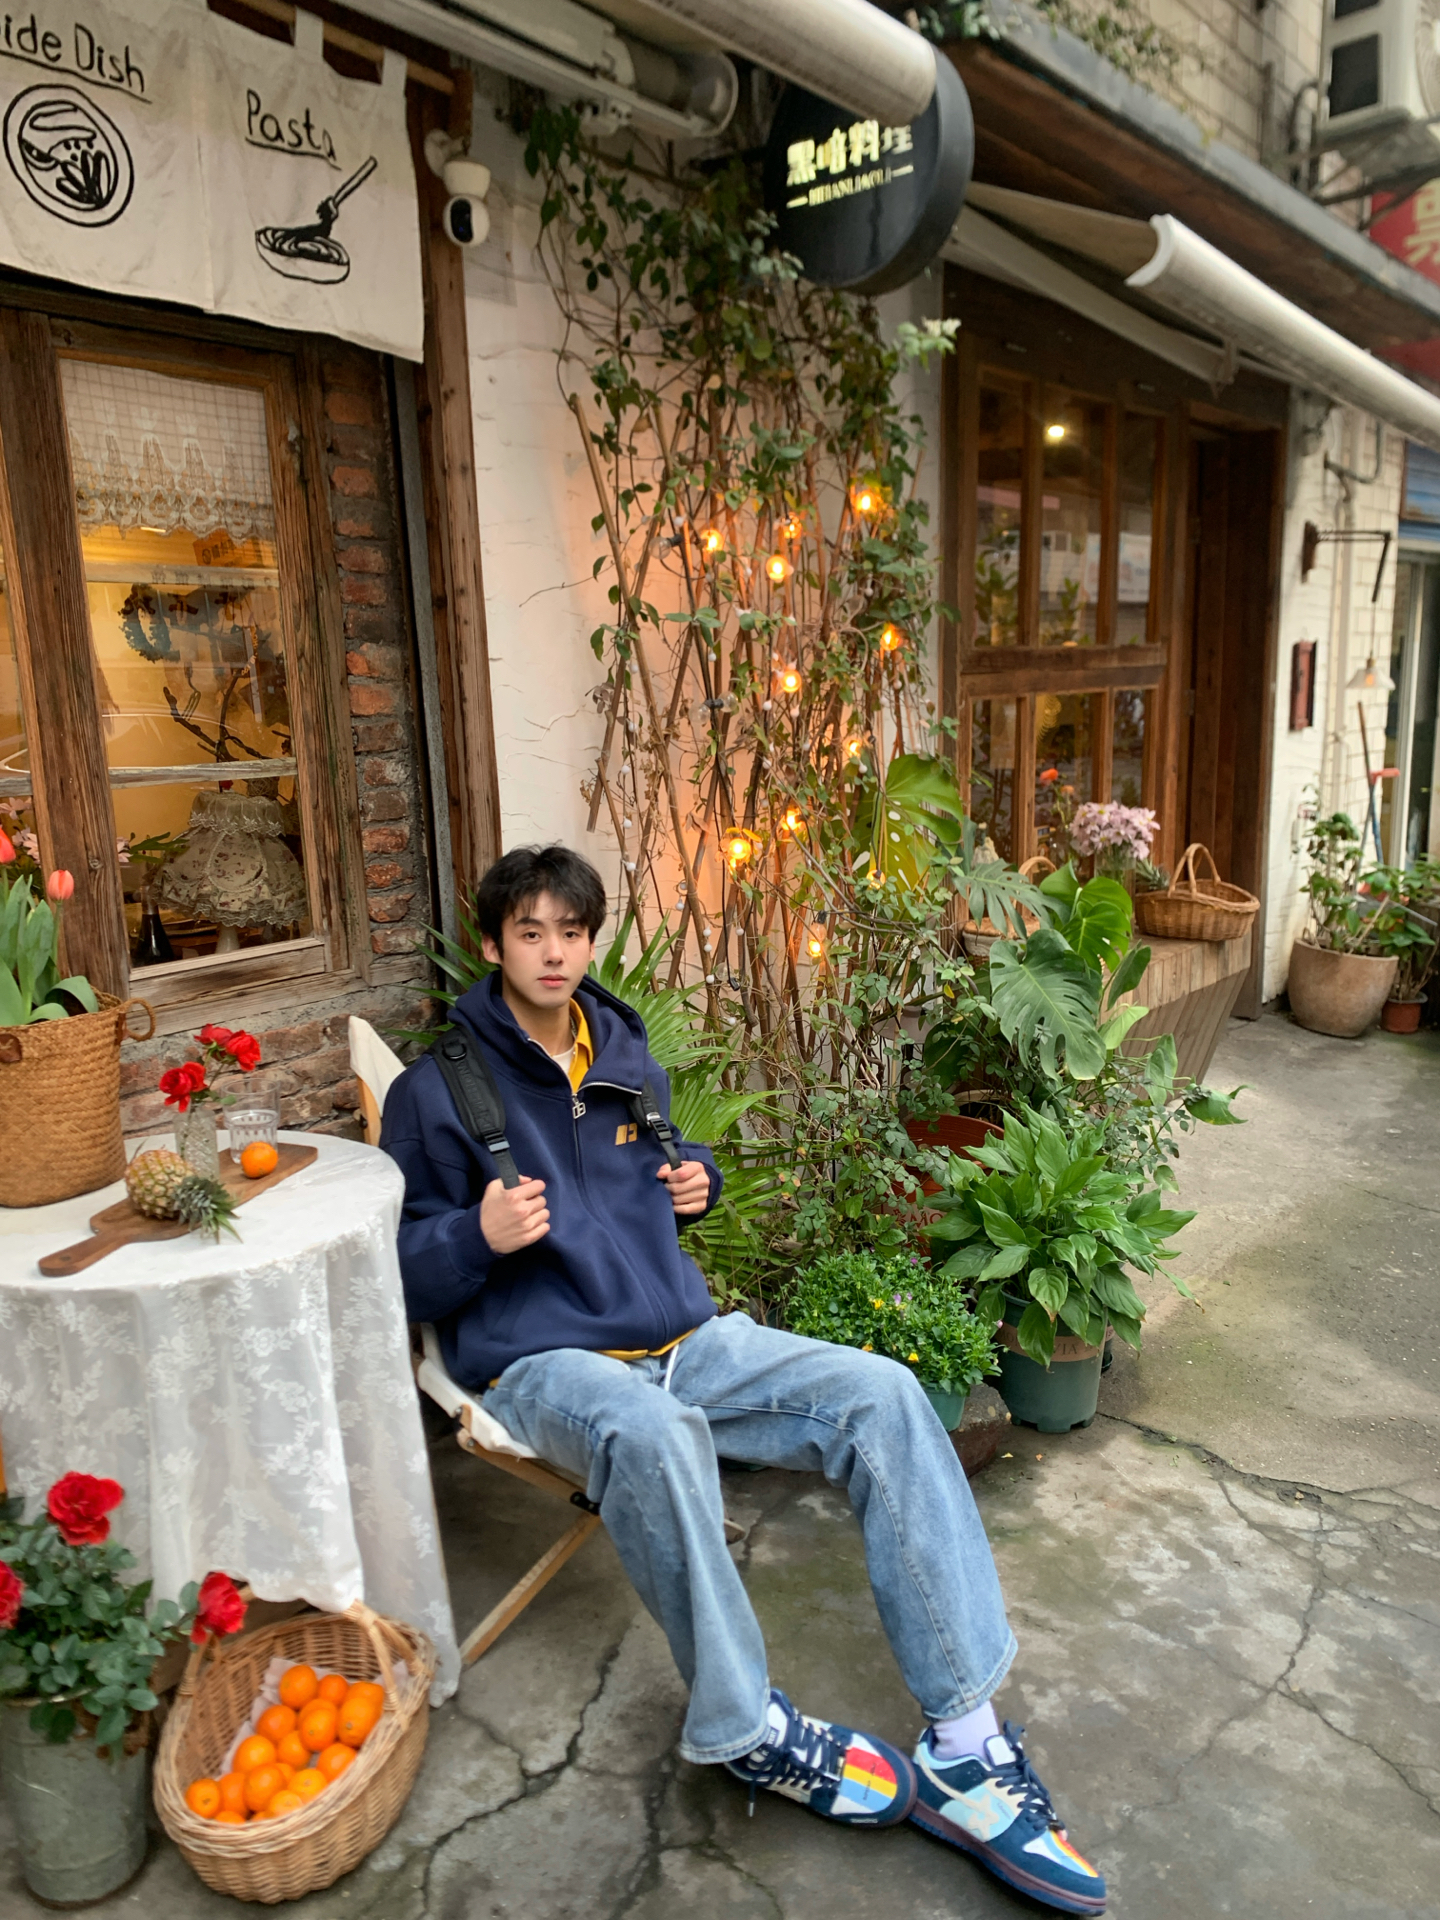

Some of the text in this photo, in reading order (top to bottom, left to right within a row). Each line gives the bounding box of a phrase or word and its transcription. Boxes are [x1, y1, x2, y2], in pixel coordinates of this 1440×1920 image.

[0, 13, 145, 93] ide Dish
[246, 88, 337, 161] Pasta
